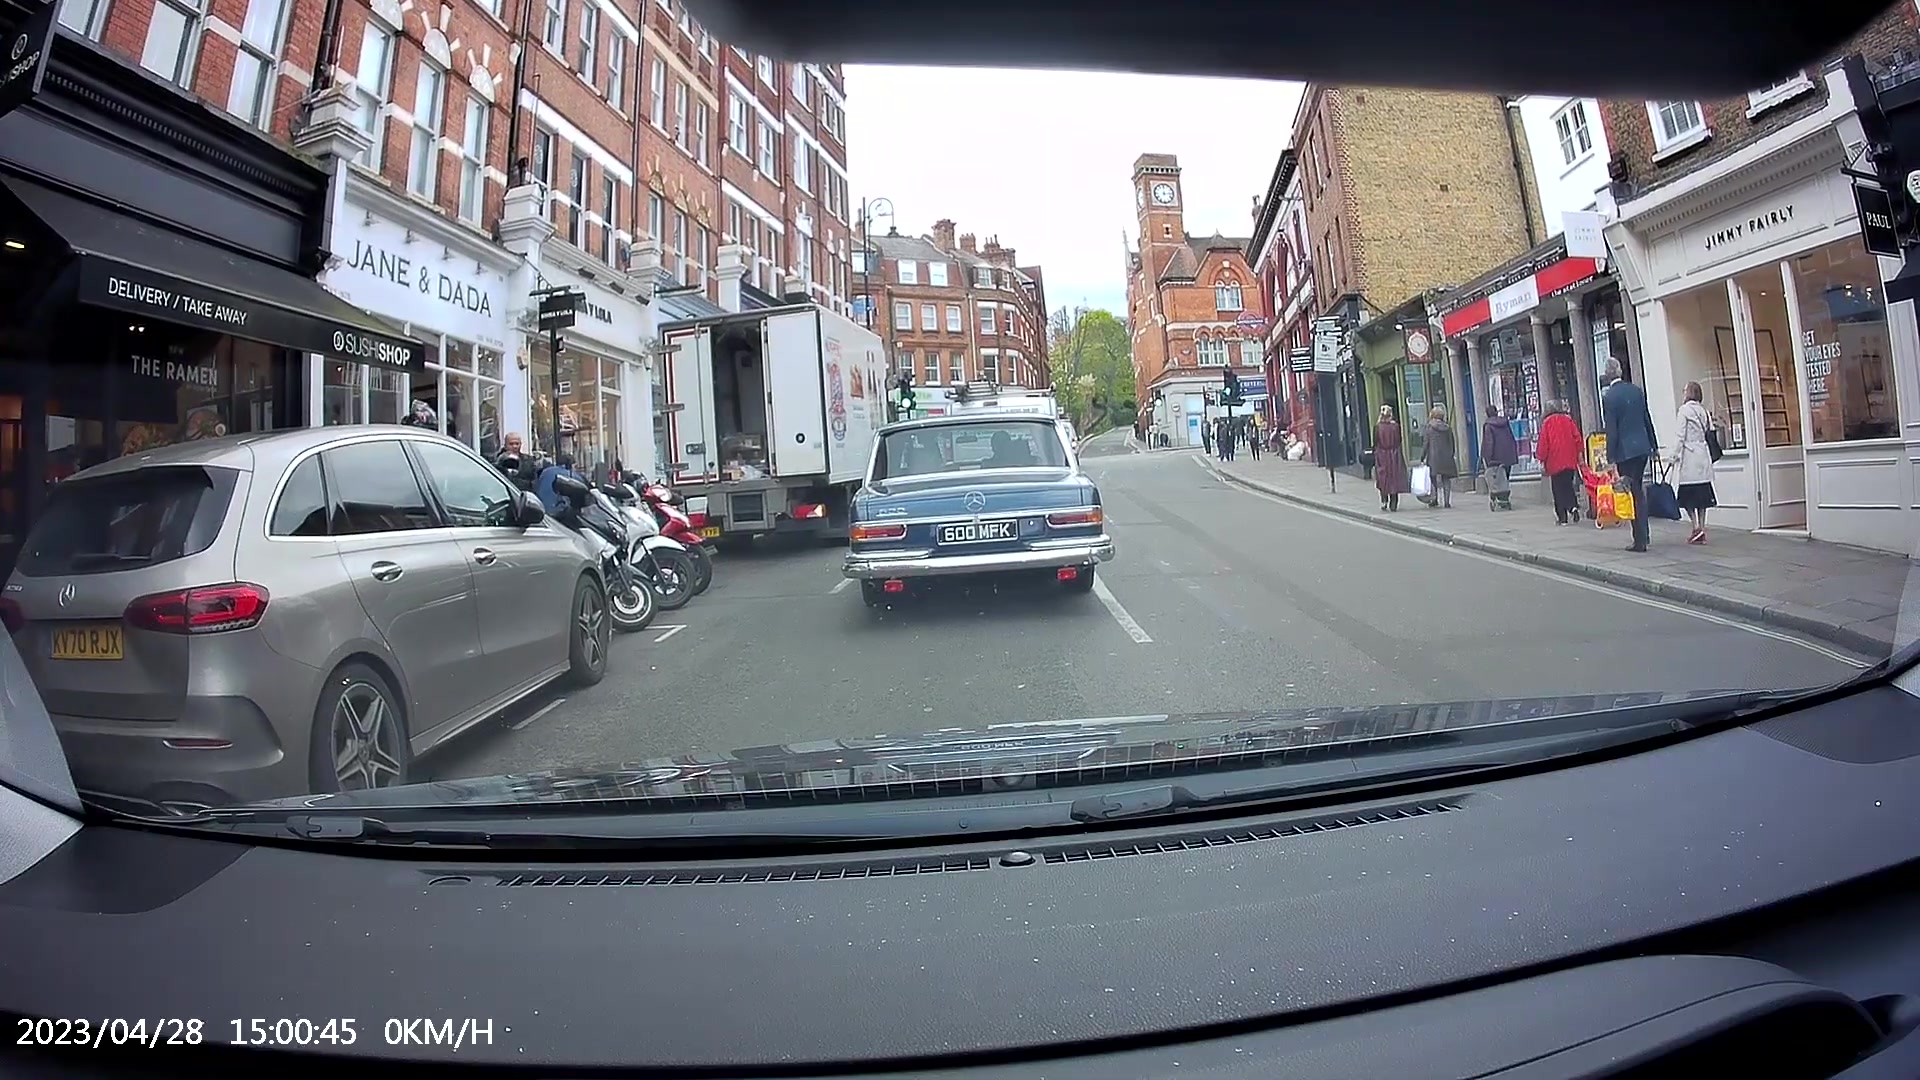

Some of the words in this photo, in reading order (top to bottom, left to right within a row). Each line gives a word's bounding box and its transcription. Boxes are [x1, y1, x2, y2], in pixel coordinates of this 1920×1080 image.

[1705, 223, 1744, 251] JIMMY
[1748, 205, 1795, 232] FAIRLY
[1866, 212, 1892, 229] PAUL
[347, 240, 411, 287] JANE
[419, 267, 430, 294] &
[438, 276, 492, 318] DADA
[108, 277, 172, 307] DELIVERY
[173, 295, 181, 309] /
[182, 295, 212, 318] TAKE
[214, 300, 248, 326] AWAY
[1494, 291, 1532, 315] Ryman
[1822, 342, 1841, 359] EYES
[131, 355, 161, 377] THE
[166, 361, 218, 386] RAMEN
[1806, 361, 1832, 378] TESTED
[945, 526, 975, 542] 600
[979, 523, 1011, 539] MFK
[53, 630, 87, 654] KV70
[90, 630, 120, 654] RJX
